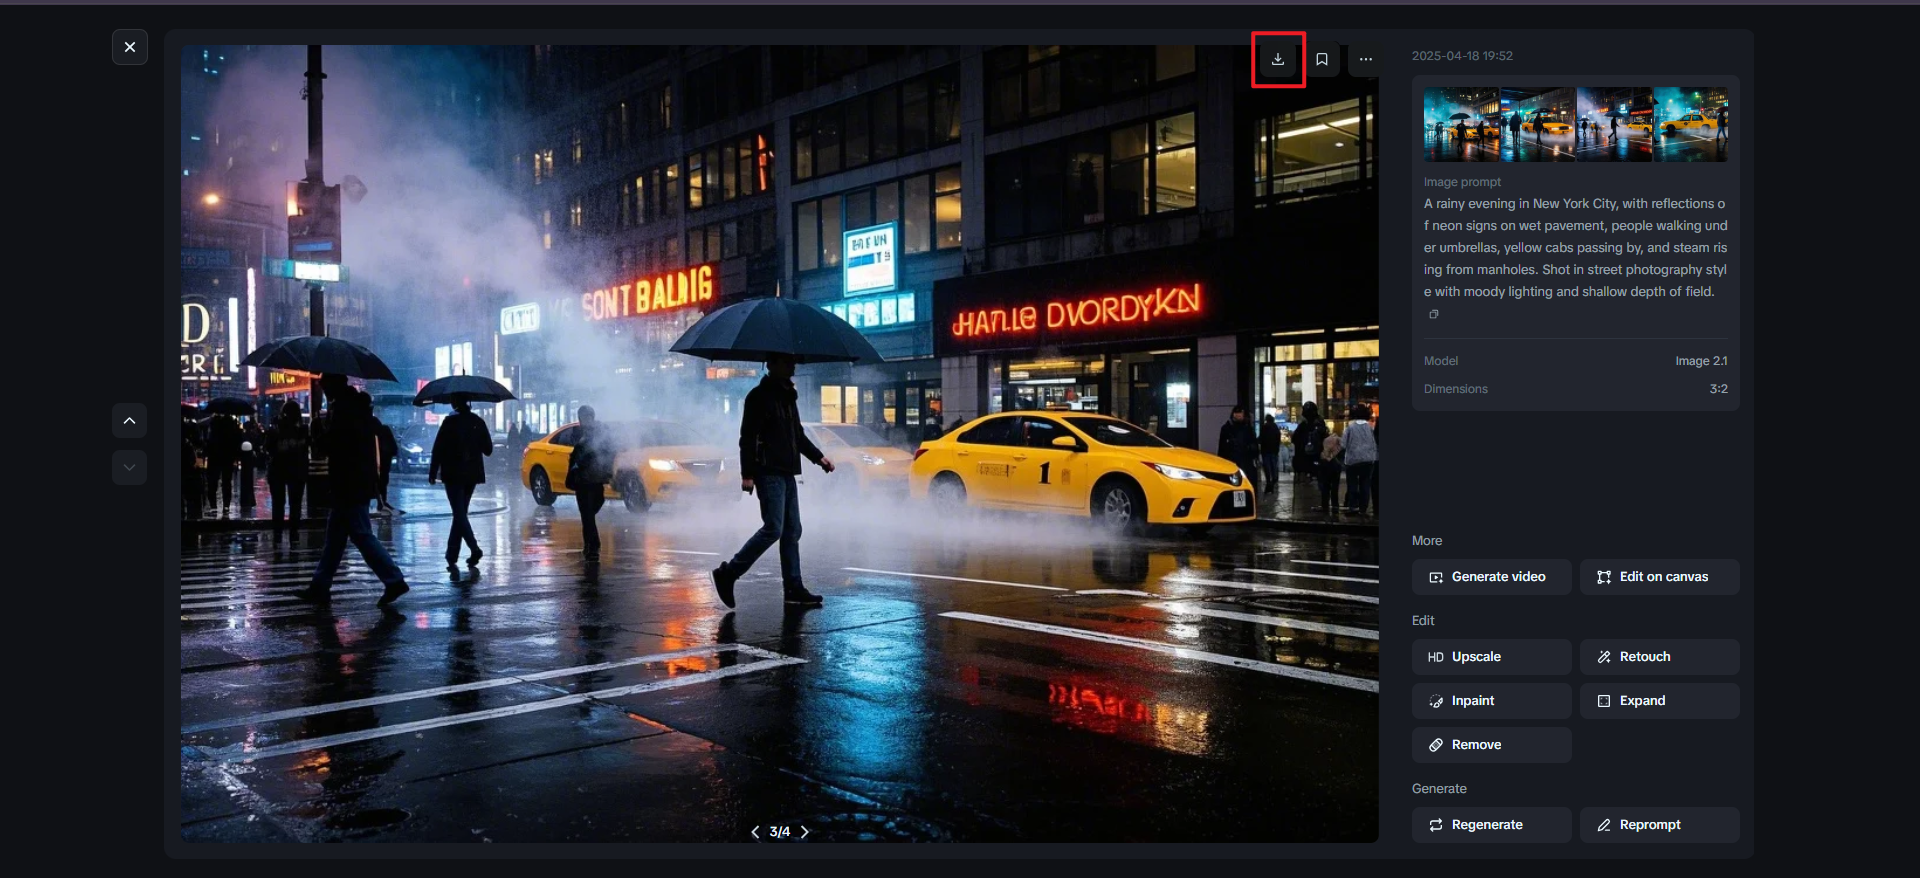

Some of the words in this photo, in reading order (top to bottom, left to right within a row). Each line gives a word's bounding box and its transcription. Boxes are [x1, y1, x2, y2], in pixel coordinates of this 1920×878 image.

[1412, 51, 1479, 61] 2025-04-18
[1483, 51, 1513, 61] 19:52
[1424, 177, 1458, 189] Image
[1461, 177, 1501, 189] prompt
[1424, 198, 1433, 208] A
[1437, 198, 1465, 211] rainy
[1468, 198, 1515, 211] evening
[1519, 198, 1529, 208] in
[1533, 198, 1560, 209] New
[1563, 198, 1590, 209] York
[1593, 198, 1619, 211] City,
[1622, 198, 1648, 209] with
[1652, 198, 1714, 209] reflections
[1717, 201, 1725, 209] o
[1424, 220, 1429, 230] f
[1433, 223, 1462, 231] neon
[1466, 220, 1497, 233] signs
[1500, 223, 1516, 231] on
[1519, 221, 1541, 231] wet
[1545, 221, 1608, 233] pavement,
[1612, 220, 1653, 233] people
[1656, 220, 1701, 233] walking
[1705, 220, 1728, 231] und
[1424, 245, 1437, 253] er
[1440, 242, 1500, 255] umbrellas,
[1503, 242, 1542, 255] yellow
[1545, 242, 1574, 253] cabs
[1577, 242, 1623, 255] passing
[1627, 242, 1644, 255] by,
[1647, 242, 1670, 253] and
[1673, 243, 1709, 253] steam
[1714, 242, 1727, 253] ris
[1424, 264, 1442, 277] ing
[1446, 264, 1473, 275] from
[1477, 264, 1538, 275] manholes.
[1542, 264, 1570, 275] Shot
[1574, 264, 1584, 274] in
[1587, 265, 1623, 275] street
[1626, 264, 1703, 277] photography
[1706, 264, 1727, 277] styl
[1424, 289, 1432, 297] e
[1435, 286, 1460, 297] with
[1464, 286, 1506, 299] moody
[1509, 286, 1553, 299] lighting
[1556, 286, 1579, 297] and
[1582, 286, 1627, 297] shallow
[1630, 286, 1666, 299] depth
[1669, 286, 1682, 297] of
[1685, 286, 1715, 297] field.
[1424, 356, 1458, 366] Model
[1676, 356, 1710, 368] Image
[1713, 356, 1727, 365] 2.1
[1424, 384, 1488, 394] Dimensions
[1710, 384, 1728, 394] 3:2
[1038, 461, 1051, 485] 1
[1412, 535, 1443, 546] More
[1452, 571, 1508, 582] Generate
[1512, 571, 1546, 582] video
[1620, 571, 1644, 582] Edit
[1647, 574, 1662, 582] on
[1666, 574, 1708, 582] canvas
[1412, 615, 1435, 626] Edit
[1428, 652, 1444, 662] HD
[1452, 651, 1501, 664] Upscale
[1620, 651, 1671, 662] Retouch
[1452, 695, 1495, 708] Inpaint
[1620, 695, 1665, 708] Expand
[1452, 739, 1501, 750] Remove
[1412, 783, 1467, 794] Generate
[1452, 819, 1523, 832] Regenerate
[1620, 819, 1681, 832] Reprompt
[769, 826, 791, 838] 3/4
